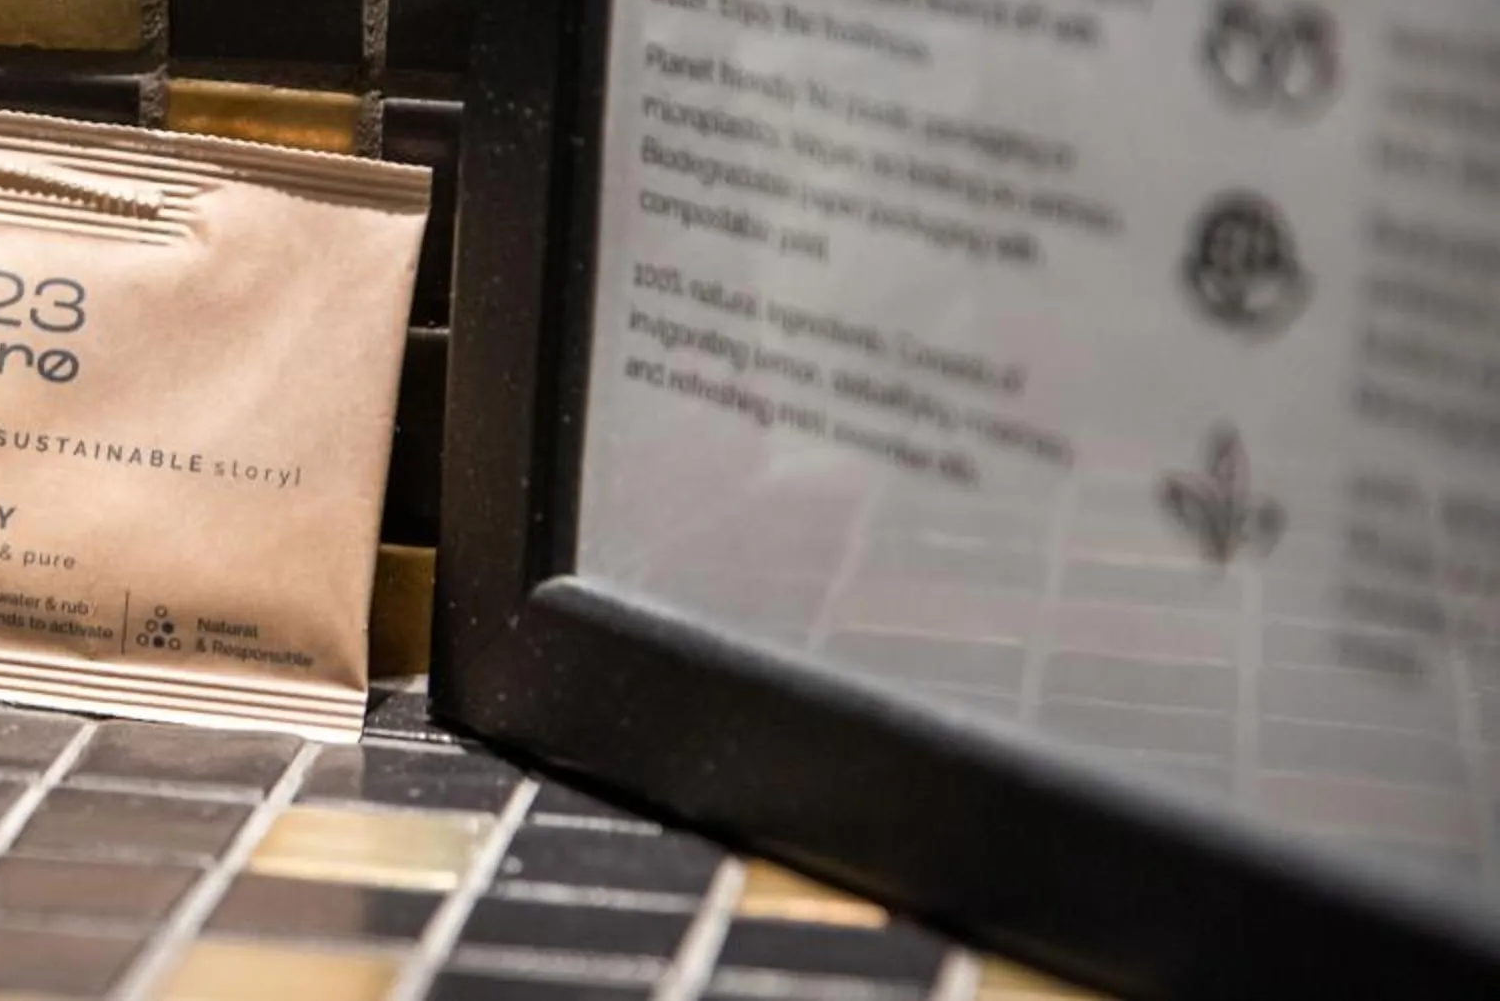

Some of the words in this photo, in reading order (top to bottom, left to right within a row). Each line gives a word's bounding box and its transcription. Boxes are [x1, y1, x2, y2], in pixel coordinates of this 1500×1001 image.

[23, 550, 77, 571] pure
[45, 596, 57, 612] &
[61, 598, 89, 615] rub
[29, 616, 47, 631] to
[49, 618, 113, 640] activate
[196, 617, 259, 639] Natural
